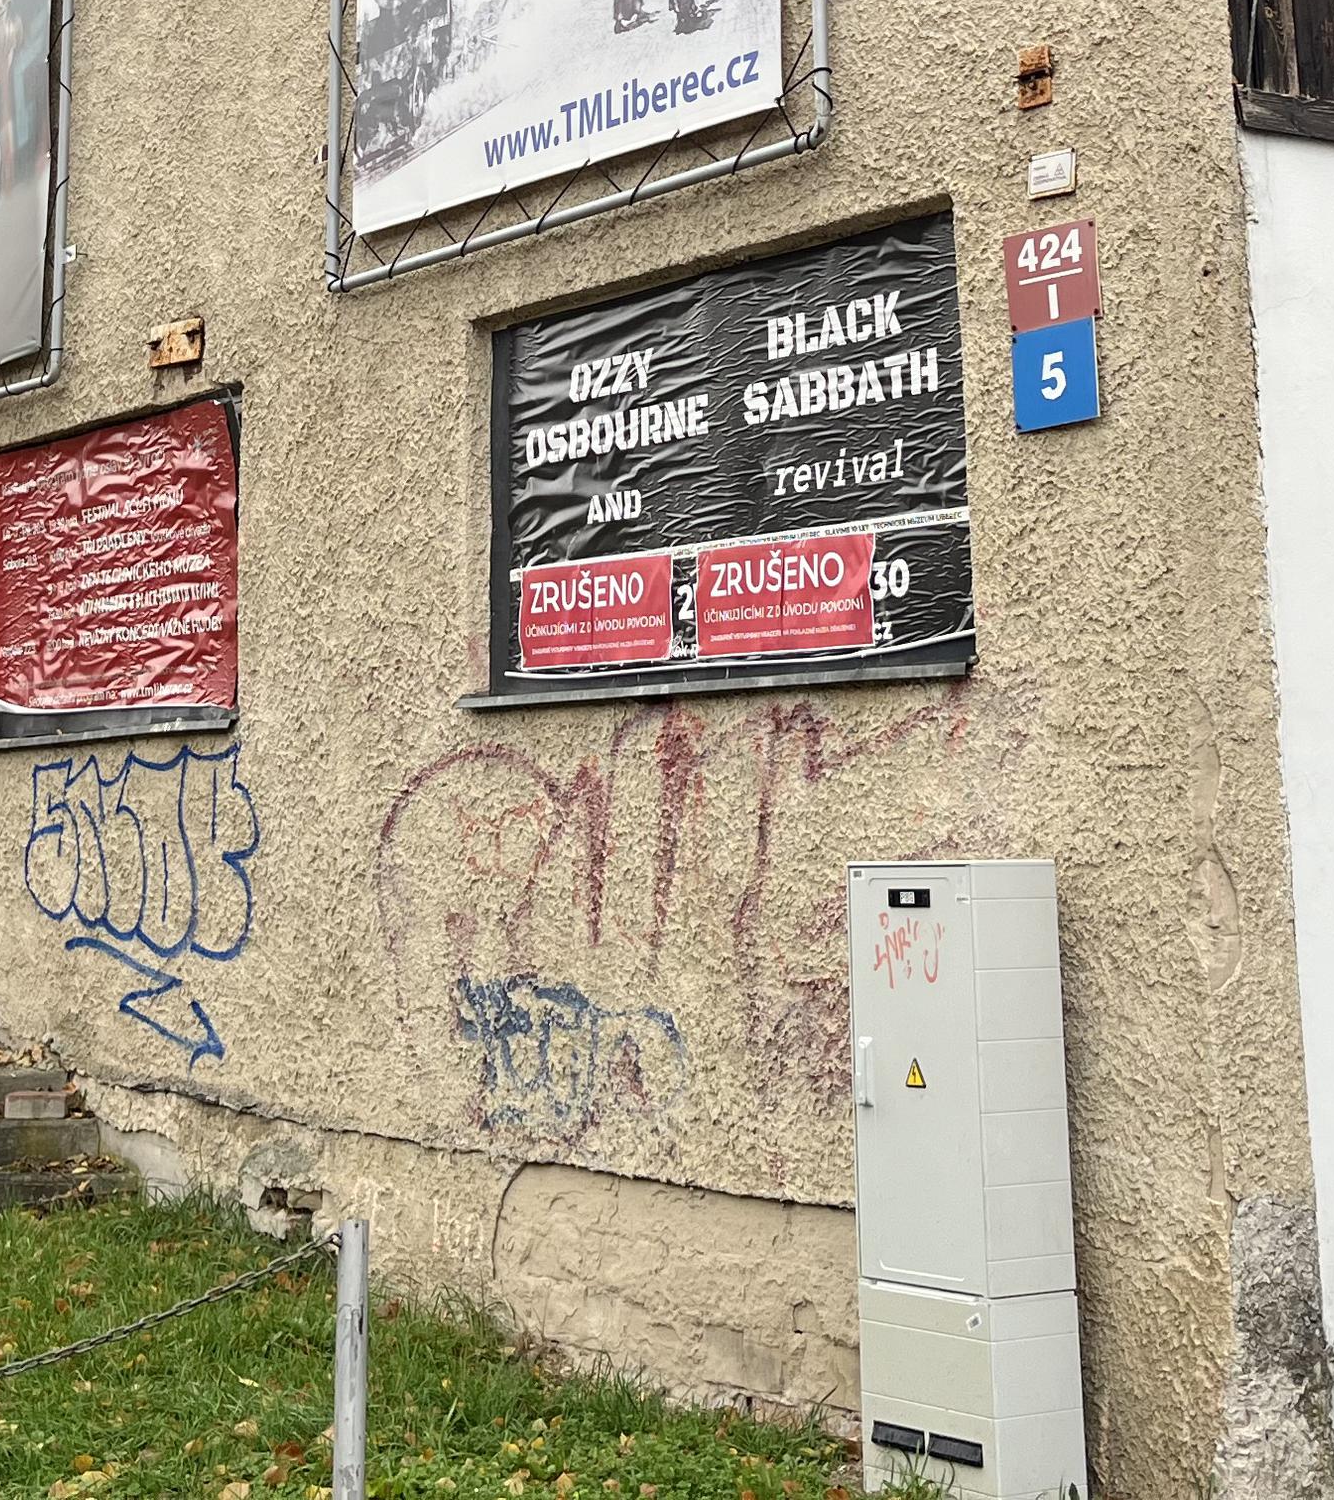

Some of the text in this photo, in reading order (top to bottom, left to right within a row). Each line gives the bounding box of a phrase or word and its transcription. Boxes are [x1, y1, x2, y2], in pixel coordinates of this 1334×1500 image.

[483, 50, 760, 168] www.TMLiberec.cz
[1017, 228, 1083, 273] 424
[767, 290, 903, 361] BLACK
[569, 346, 654, 404] OZZY
[743, 346, 940, 426] SABBATH
[1040, 351, 1067, 400] 5
[525, 393, 710, 469] OSBOURNE
[773, 438, 906, 496] revival
[586, 488, 643, 525] AND
[529, 570, 645, 614] ZRUŠENO
[710, 550, 845, 597] ZRUŠENO
[627, 612, 666, 630] POVODNÍ
[766, 605, 774, 618] Z
[820, 594, 865, 613] POVODNÍ
